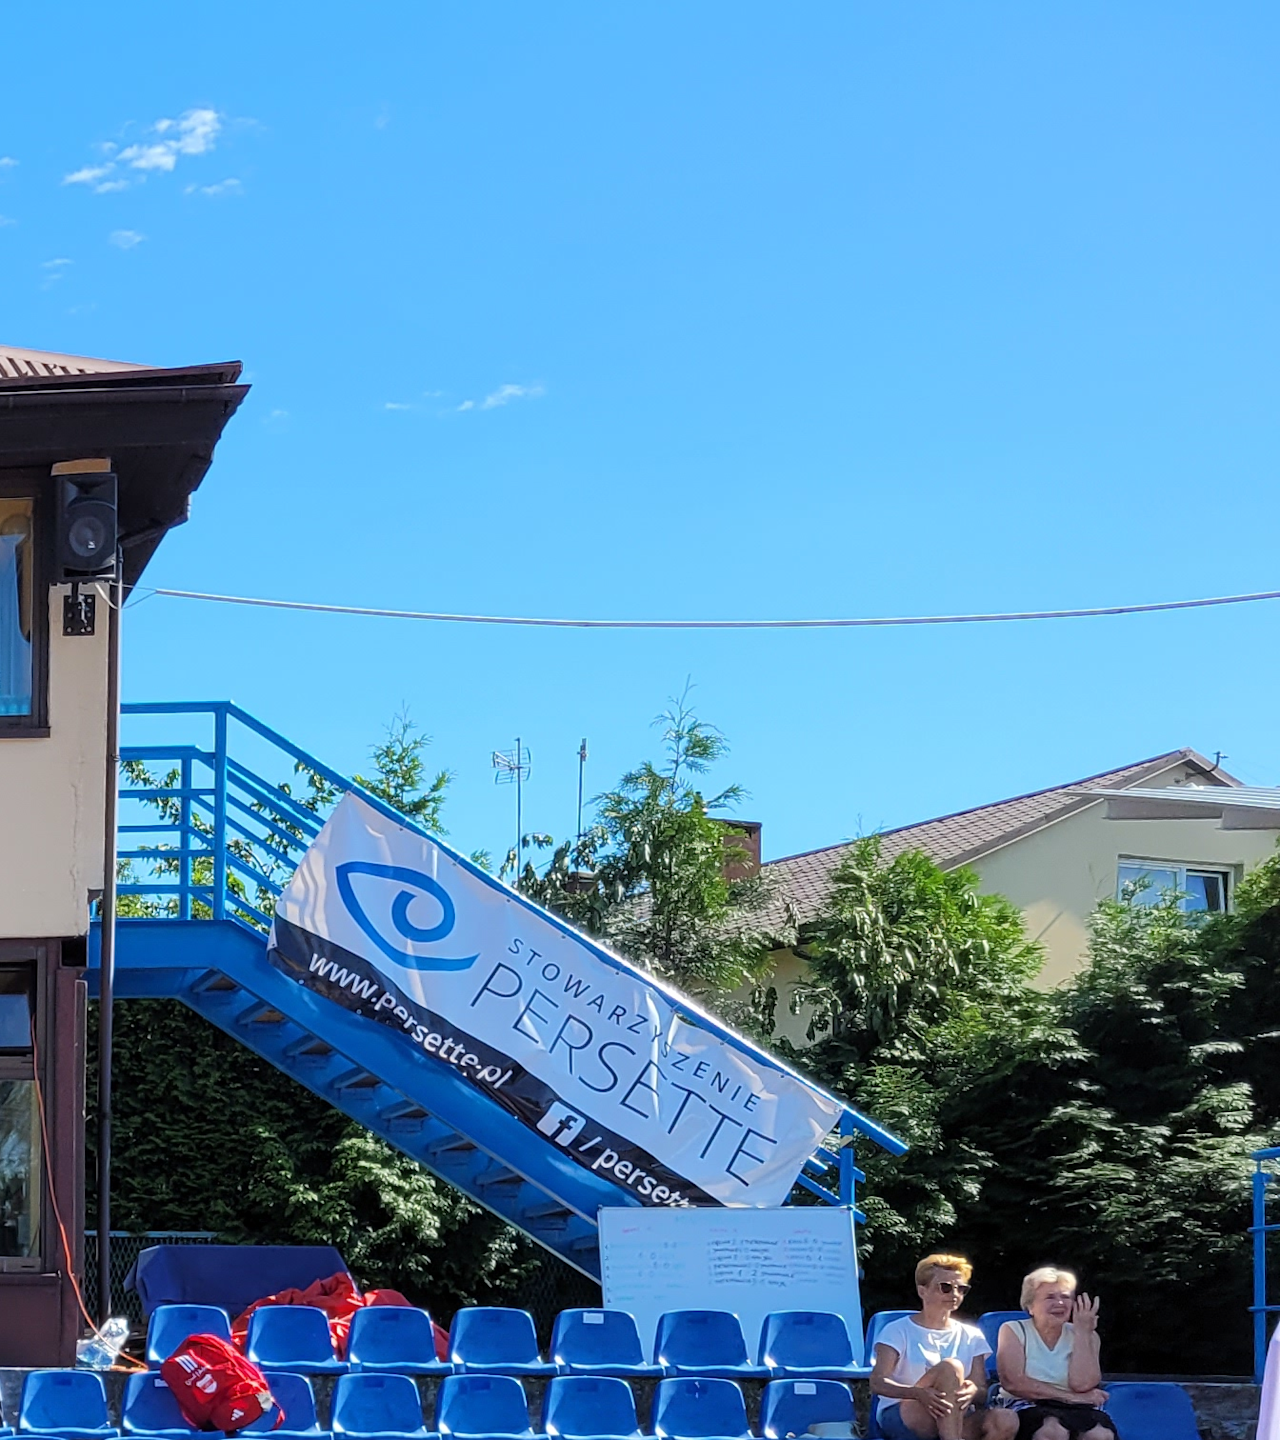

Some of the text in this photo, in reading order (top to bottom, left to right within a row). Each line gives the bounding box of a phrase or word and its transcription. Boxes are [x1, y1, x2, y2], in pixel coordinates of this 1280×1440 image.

[309, 952, 513, 1090] www.persette.pl
[469, 961, 778, 1188] PERSETTE
[507, 937, 762, 1113] STOWARZYSZENIE
[591, 1146, 697, 1209] persett
